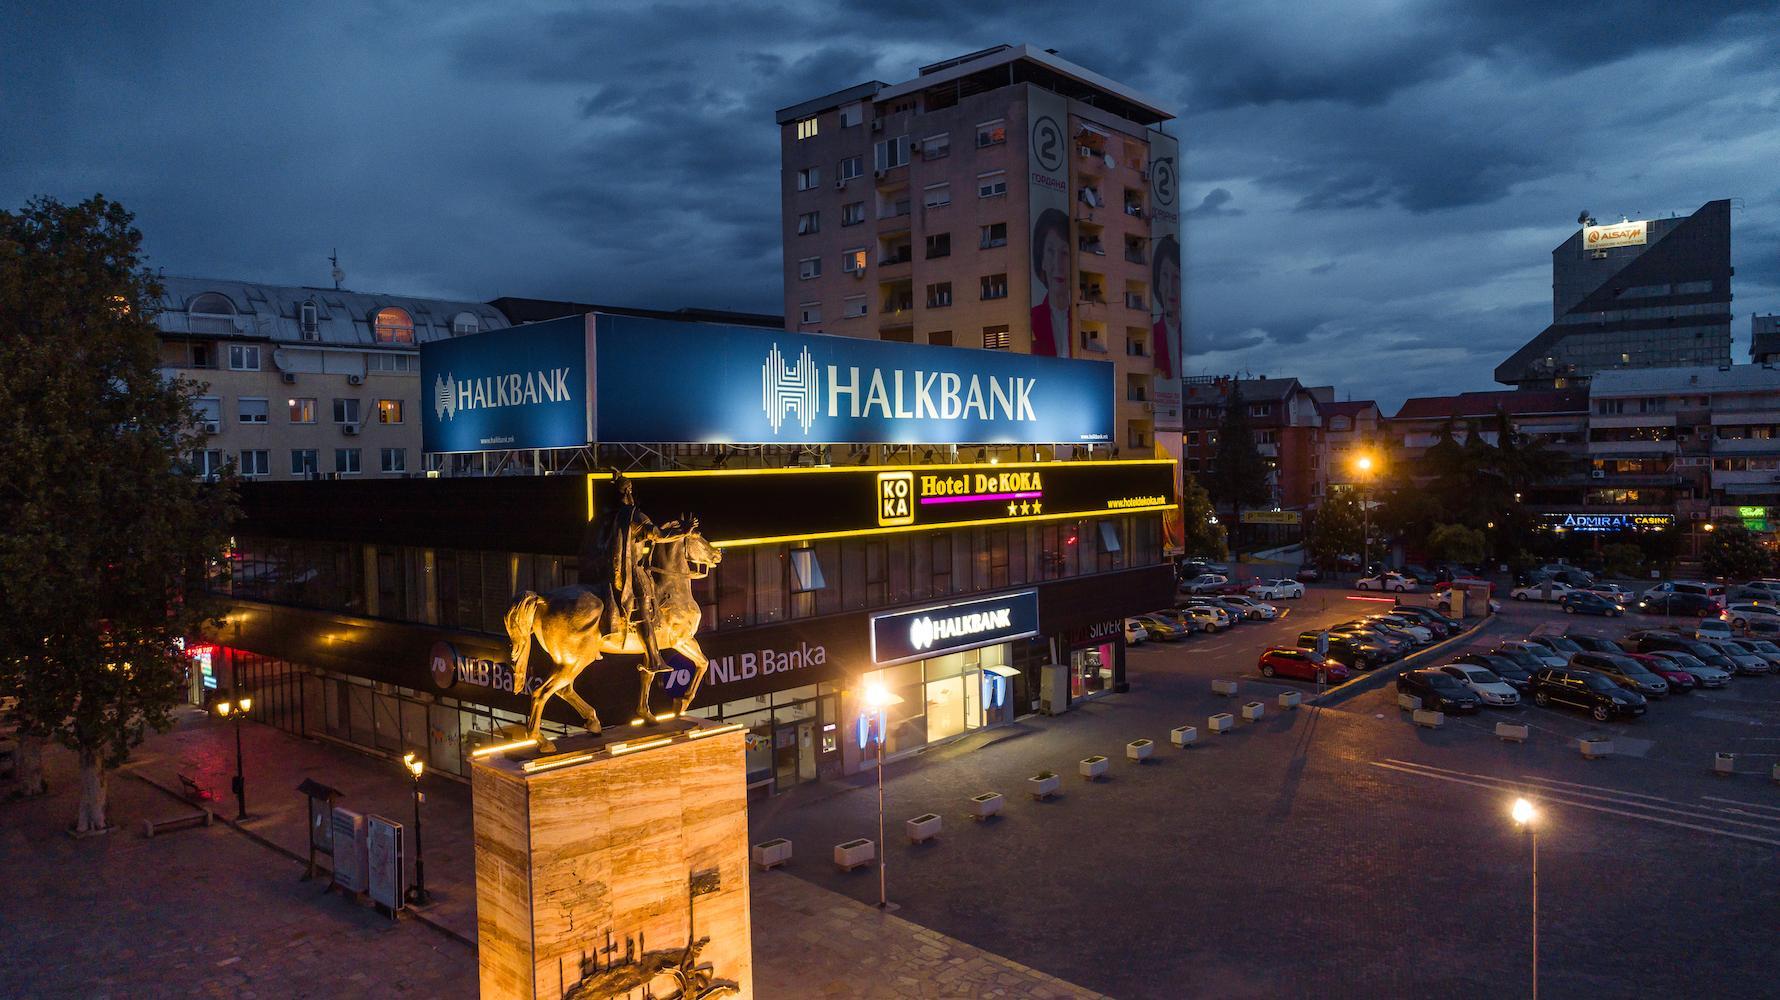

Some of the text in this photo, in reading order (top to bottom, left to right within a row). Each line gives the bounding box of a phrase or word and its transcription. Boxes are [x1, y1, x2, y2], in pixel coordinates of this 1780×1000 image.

[1040, 126, 1057, 161] 2
[1158, 166, 1170, 196] 2
[457, 367, 571, 411] HALKBANK
[827, 365, 1037, 421] HALKBANK
[883, 480, 909, 498] KO
[920, 474, 970, 496] Hotel
[883, 498, 909, 517] KA
[932, 608, 1012, 640] HALKBANK
[1089, 620, 1121, 639] SILVER
[456, 656, 490, 687] NLB
[709, 641, 827, 686] NLB Banka
